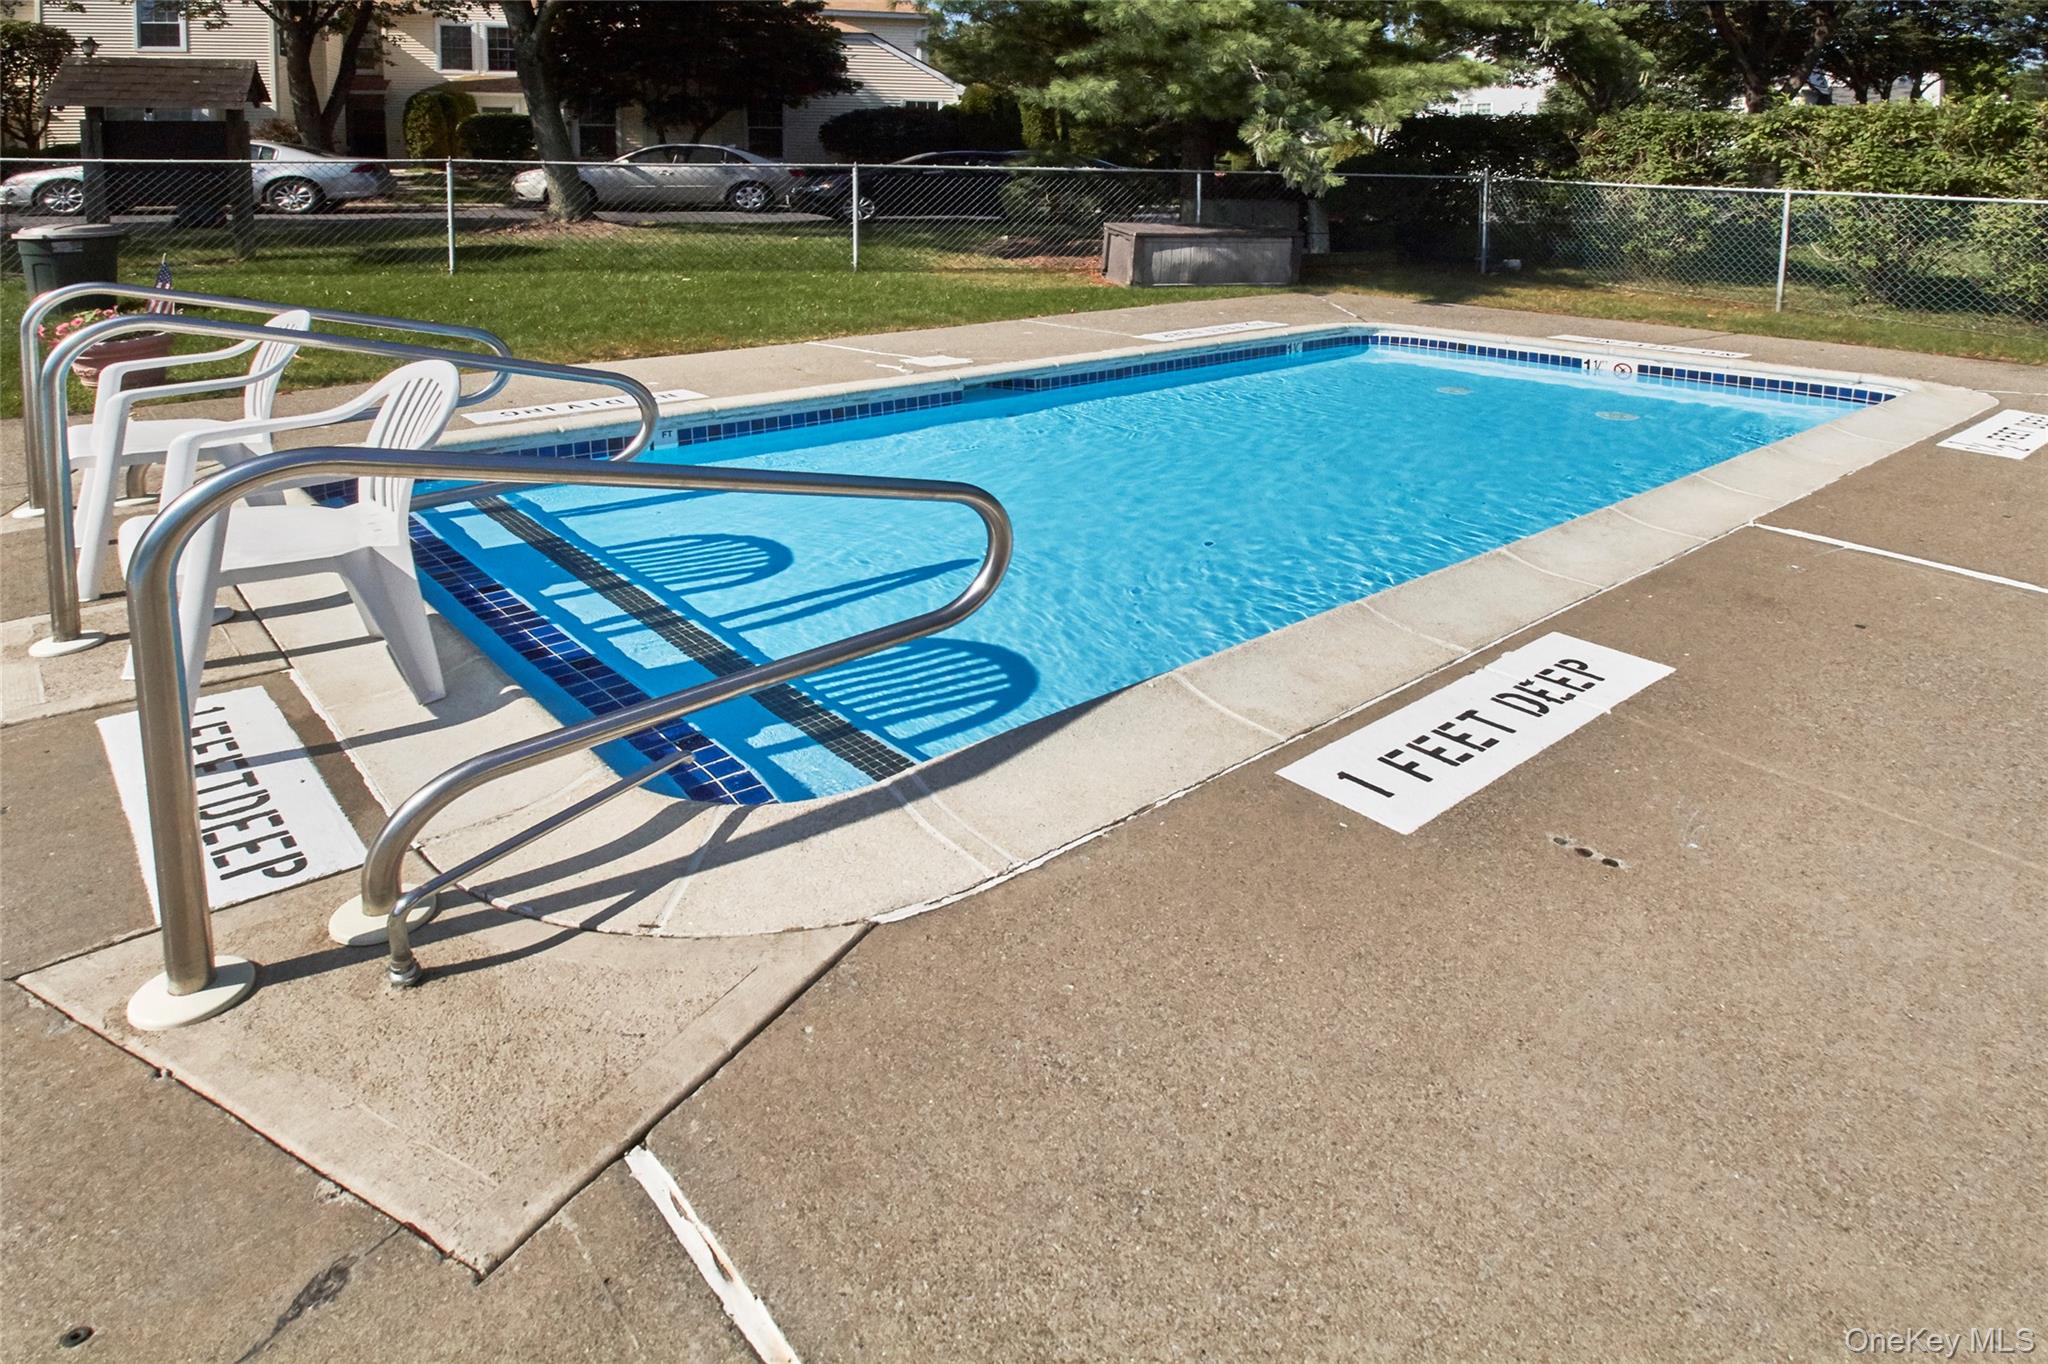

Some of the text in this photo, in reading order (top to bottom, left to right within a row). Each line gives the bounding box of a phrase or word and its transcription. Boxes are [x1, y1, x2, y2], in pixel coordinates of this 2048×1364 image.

[661, 430, 673, 439] FT
[1985, 426, 2036, 444] FEET
[1336, 658, 1606, 798] 1 FEET DEEP
[190, 706, 309, 881] 1 FEET DEEP
